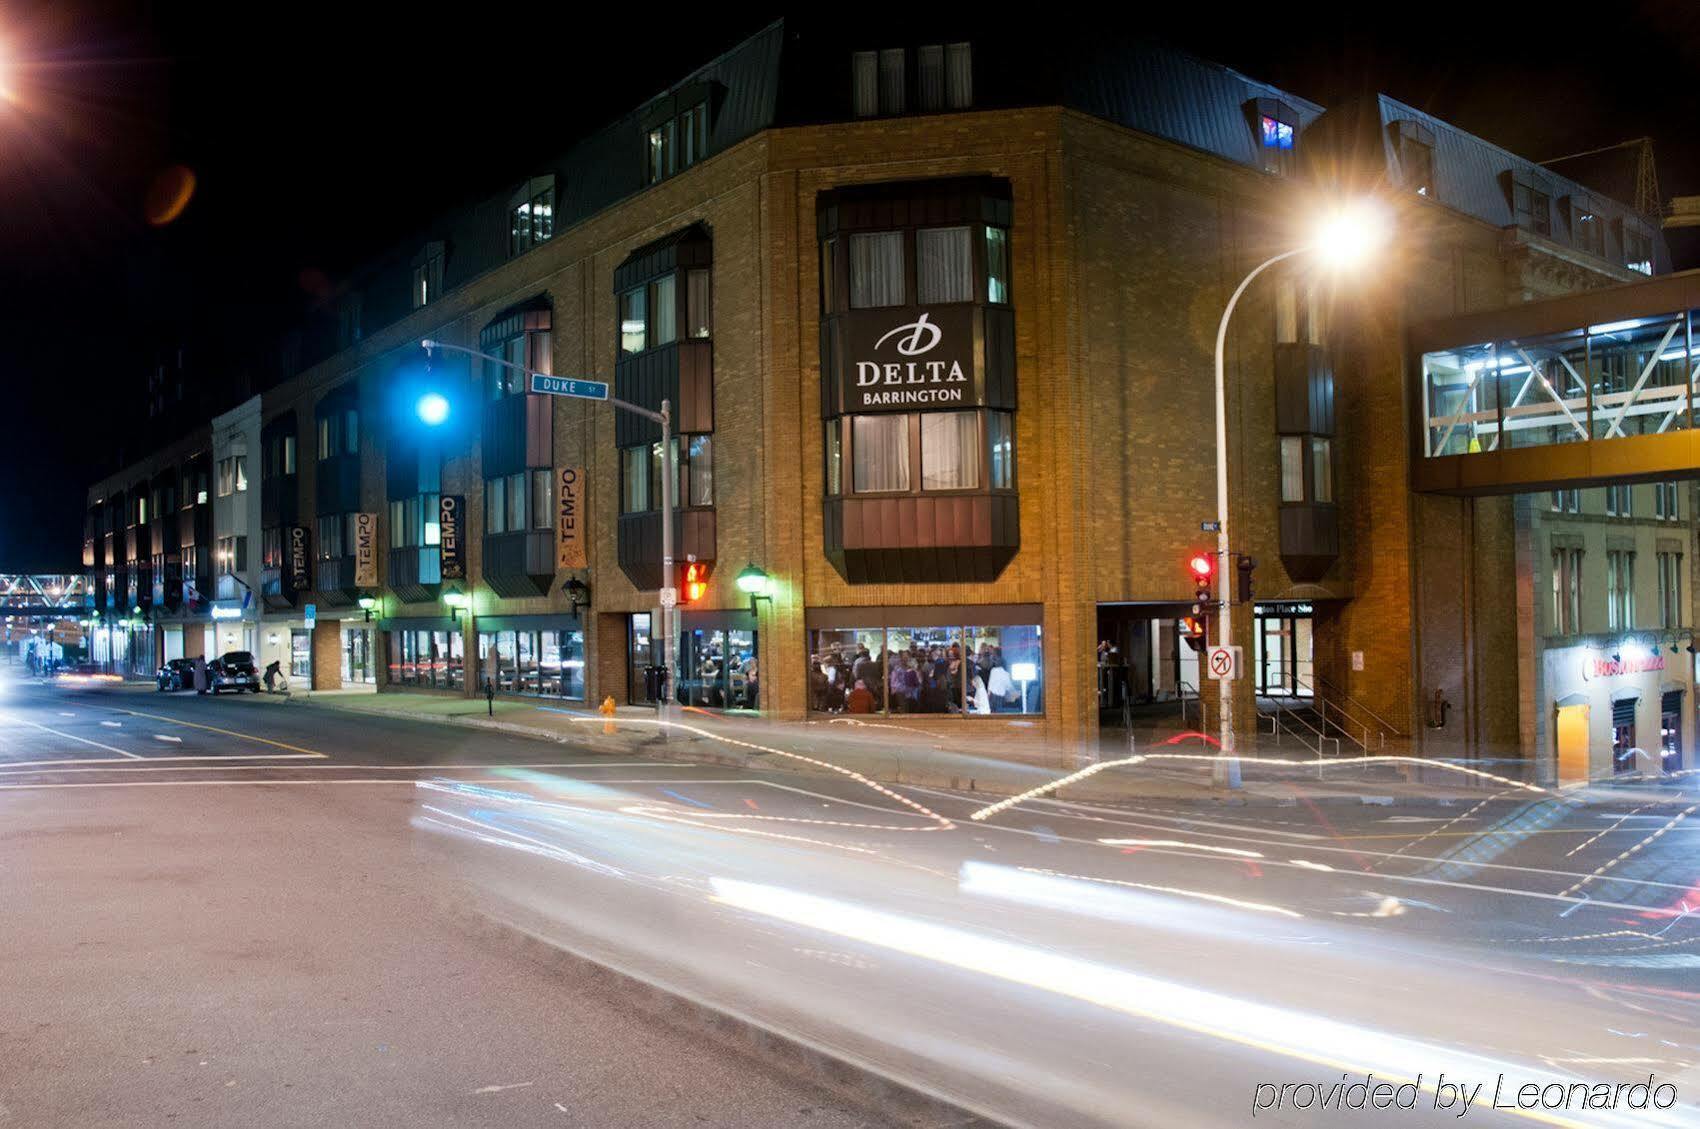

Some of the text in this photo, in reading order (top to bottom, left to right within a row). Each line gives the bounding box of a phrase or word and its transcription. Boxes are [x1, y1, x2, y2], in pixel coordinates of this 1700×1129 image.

[543, 378, 576, 393] DUKE
[856, 360, 967, 386] DELTA
[863, 389, 962, 405] BARRINGTON
[441, 496, 456, 560] TEMPO
[561, 469, 576, 543] TEMPO
[292, 527, 305, 576] TEMPO
[358, 513, 370, 568] TEMPO
